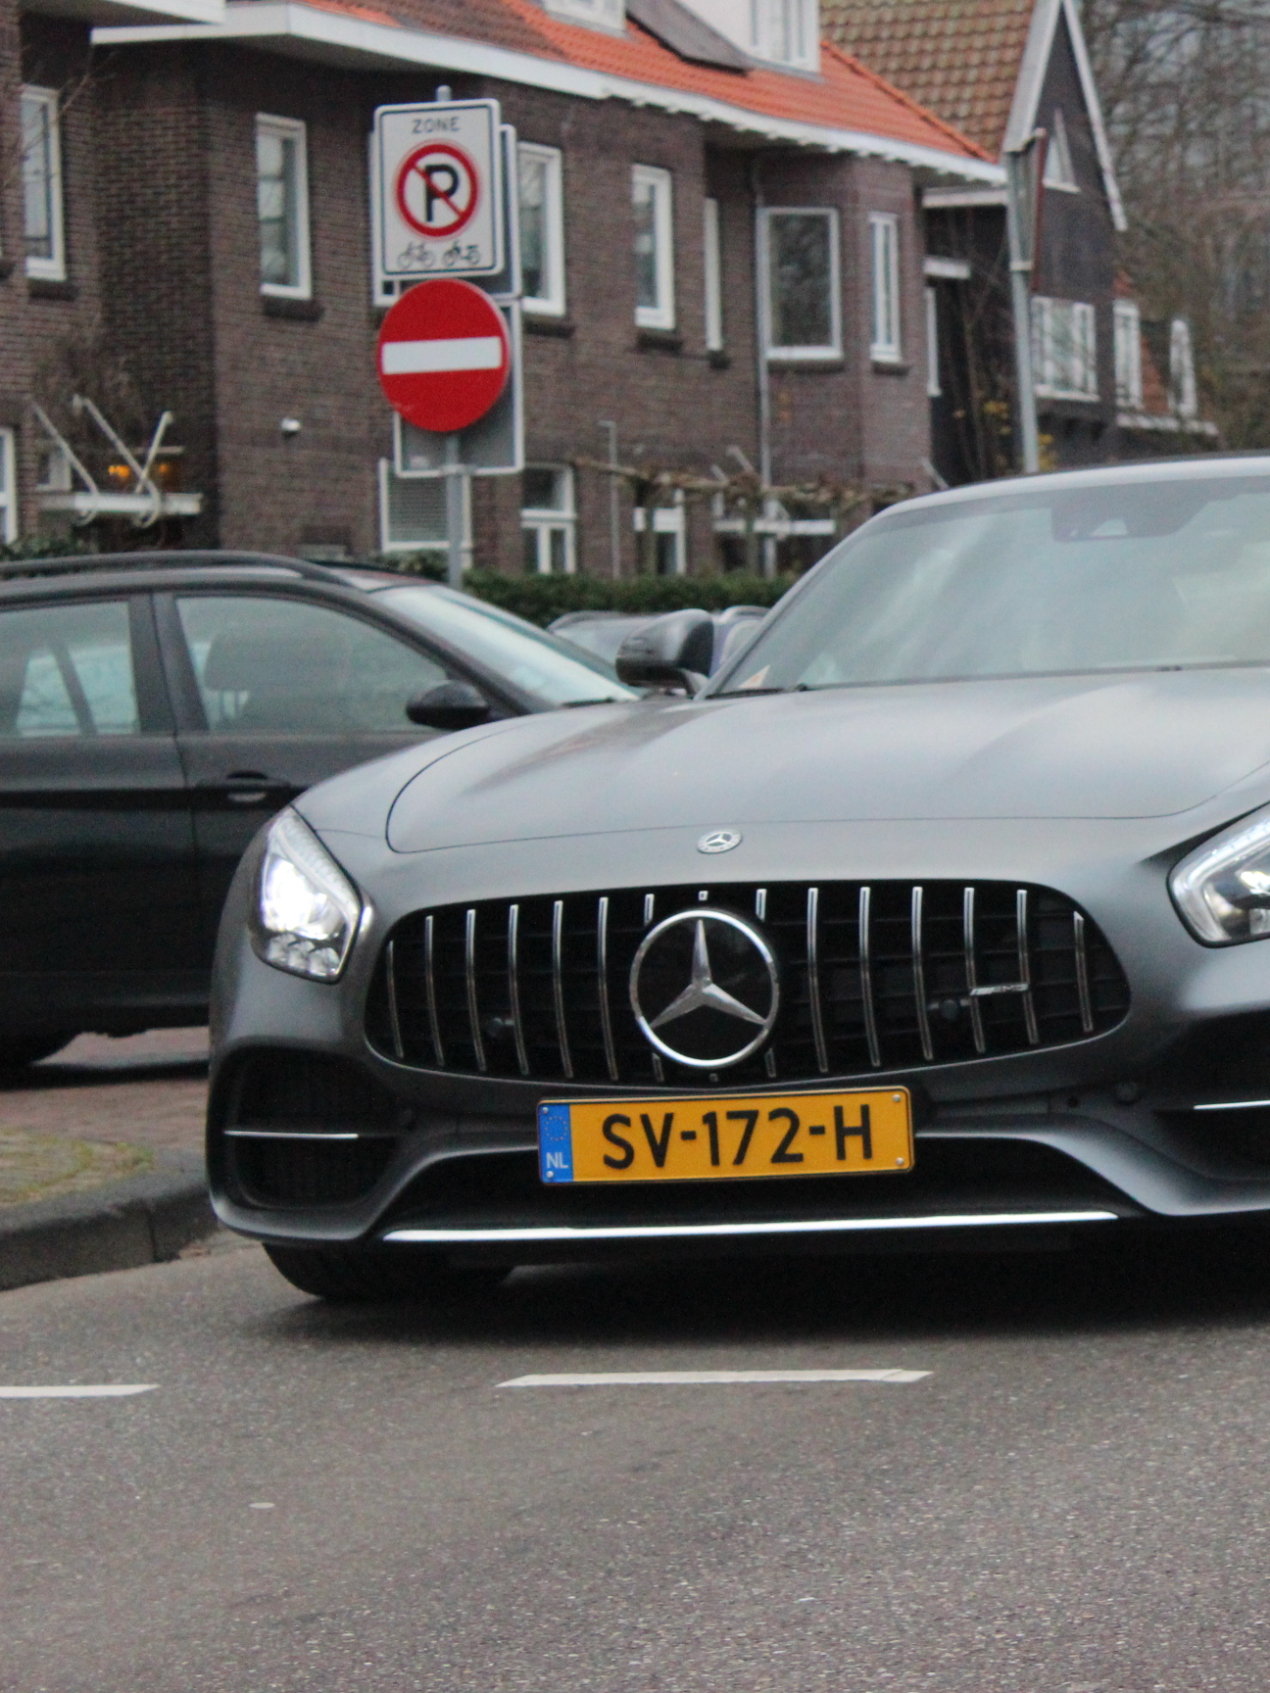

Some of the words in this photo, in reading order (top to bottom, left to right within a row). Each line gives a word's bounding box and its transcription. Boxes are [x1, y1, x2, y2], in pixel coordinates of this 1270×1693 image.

[412, 116, 461, 134] ZONE
[424, 163, 459, 222] P
[601, 1103, 873, 1171] SV-172-H
[545, 1151, 569, 1169] NL
